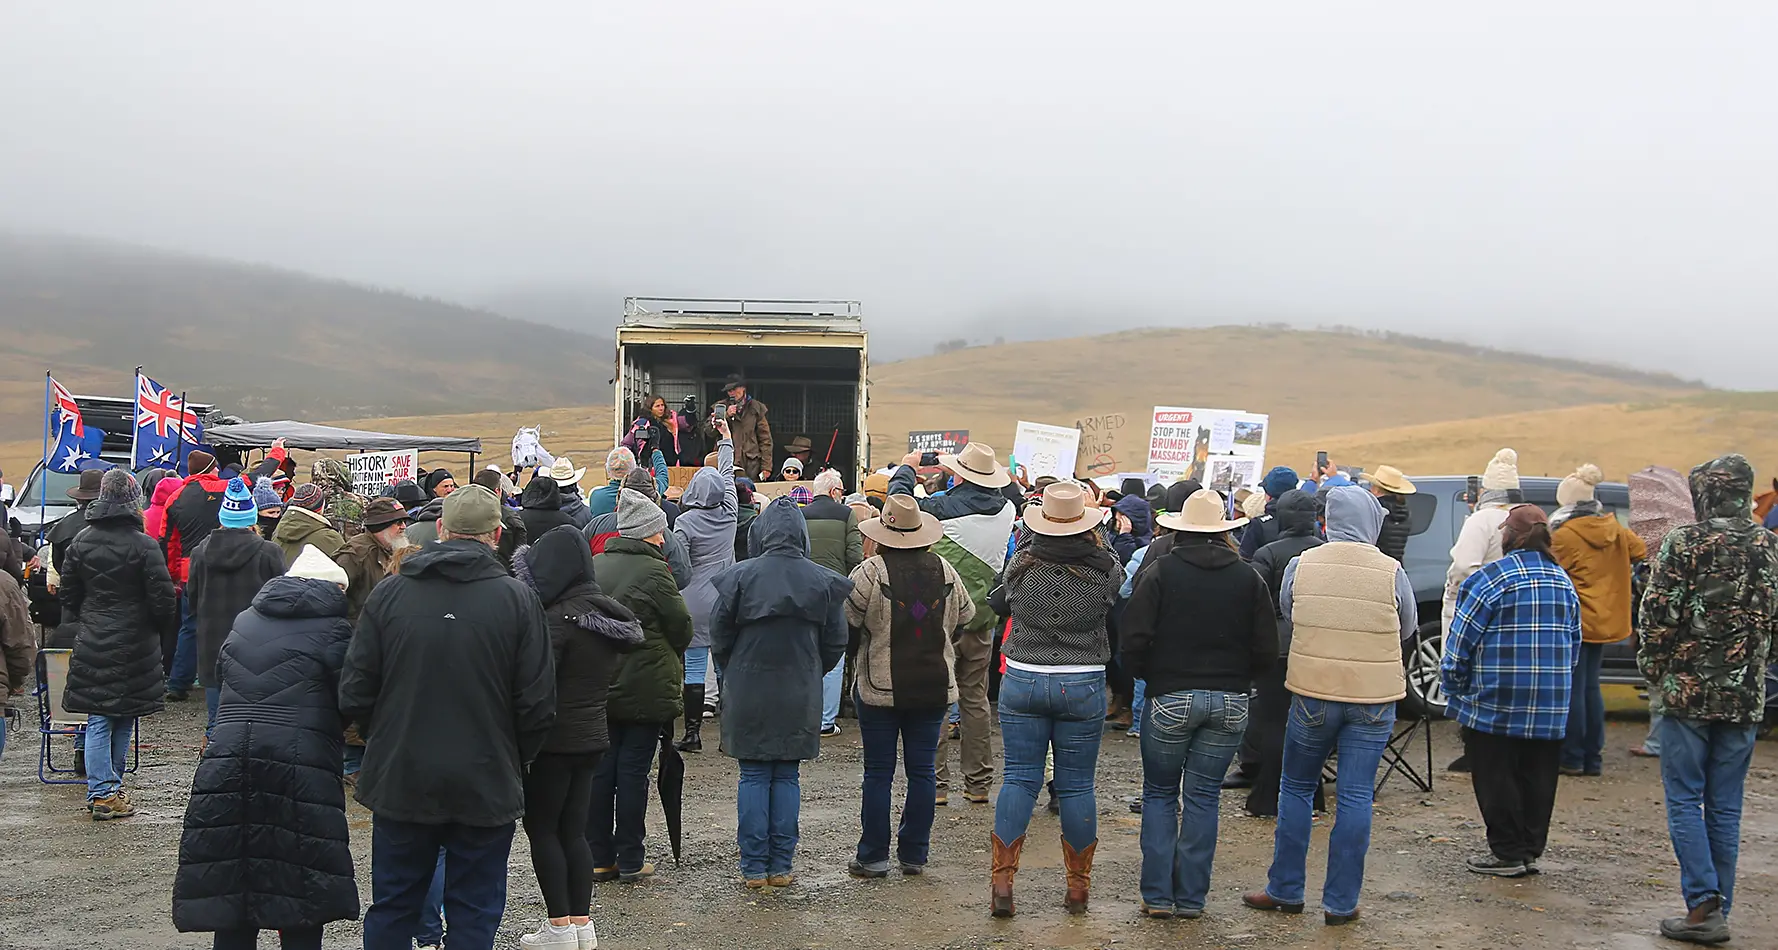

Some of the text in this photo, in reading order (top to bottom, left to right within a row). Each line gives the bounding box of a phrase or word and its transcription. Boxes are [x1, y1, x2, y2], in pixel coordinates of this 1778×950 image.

[1076, 414, 1126, 433] ARMED
[1158, 413, 1190, 423] URGENT!
[1106, 432, 1114, 441] A
[1153, 427, 1191, 438] STOP THE
[1079, 443, 1112, 457] MIND
[1152, 438, 1189, 450] BRUMBY
[392, 454, 411, 468] SAVE
[1150, 449, 1191, 462] MASSACRE
[349, 456, 387, 471] HISTORY
[374, 472, 383, 481] IN
[394, 468, 409, 477] OUR
